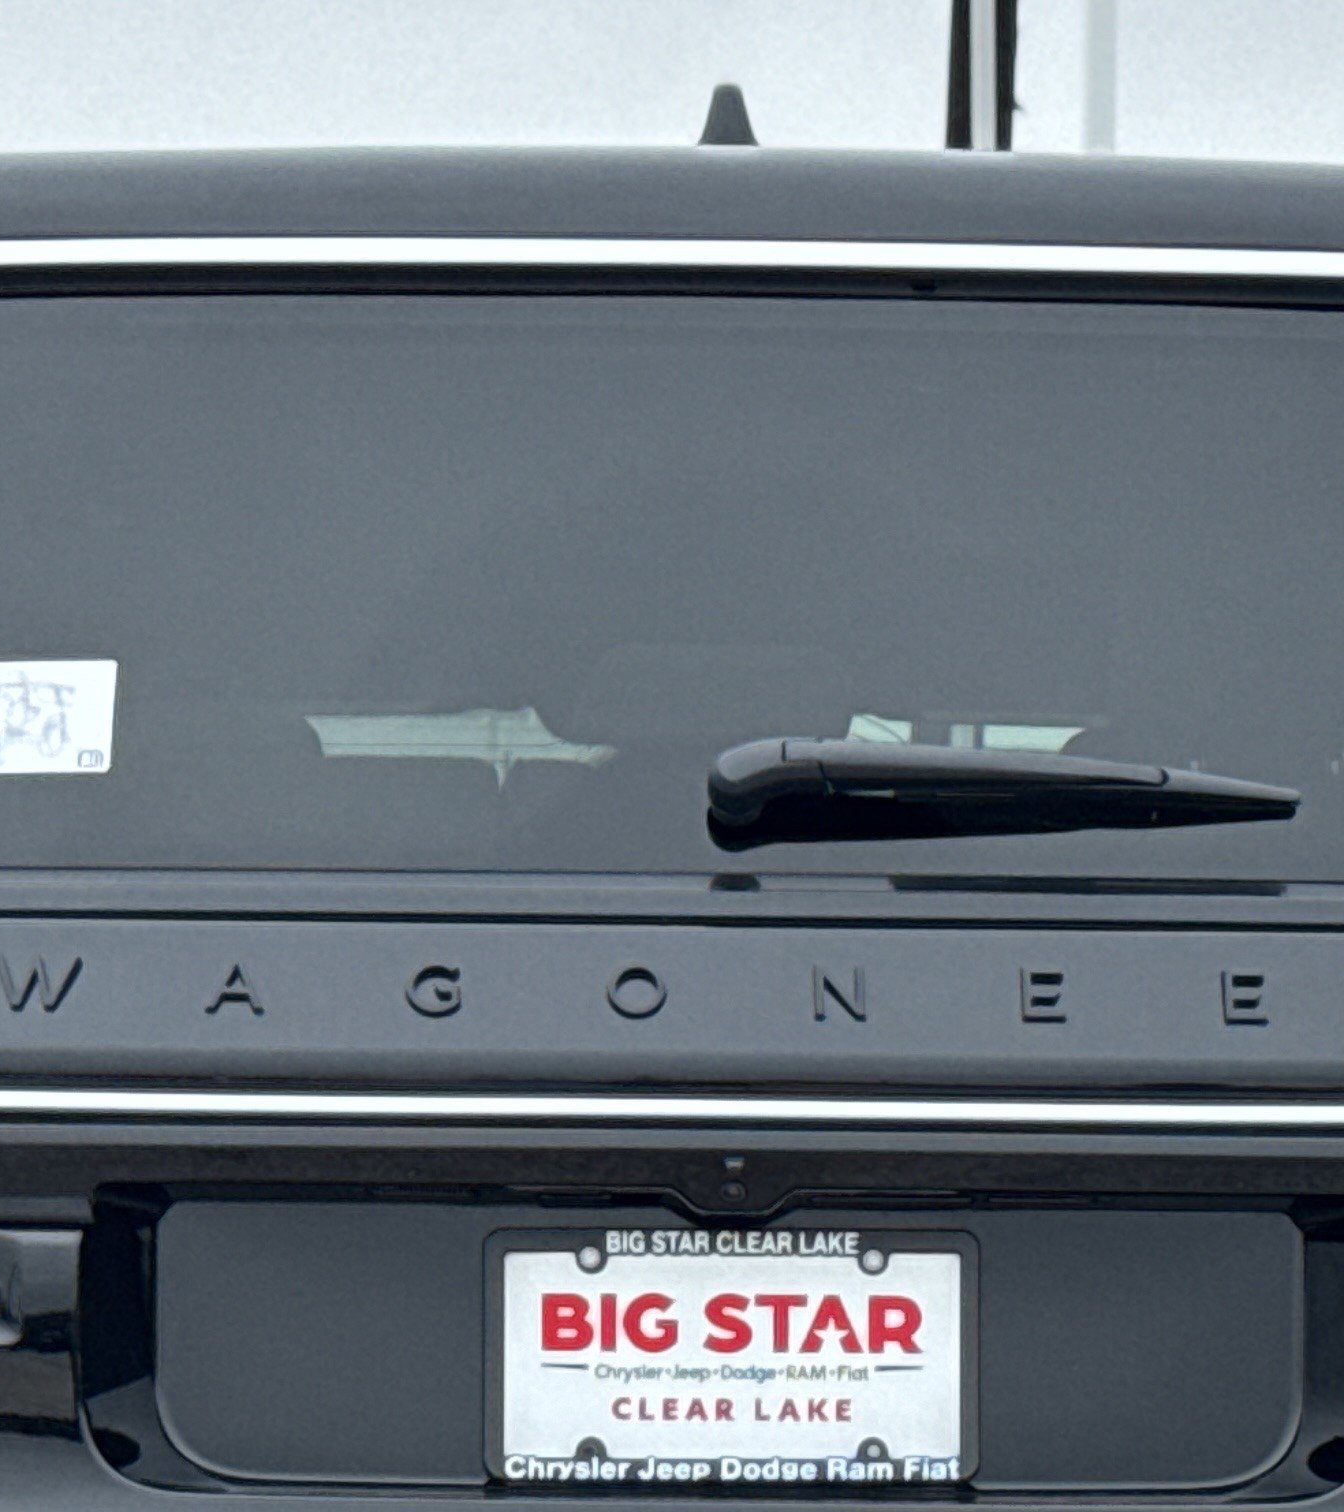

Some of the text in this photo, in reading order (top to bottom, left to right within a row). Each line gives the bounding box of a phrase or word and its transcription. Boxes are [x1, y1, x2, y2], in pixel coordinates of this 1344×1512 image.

[605, 1229, 860, 1255] BIG STAR CLEAR LAKE
[540, 1292, 924, 1354] BIG STAR
[611, 1396, 852, 1422] CLEAR LAKE
[504, 1455, 960, 1482] Chrysler Jeep Dodge Ram Fiat
